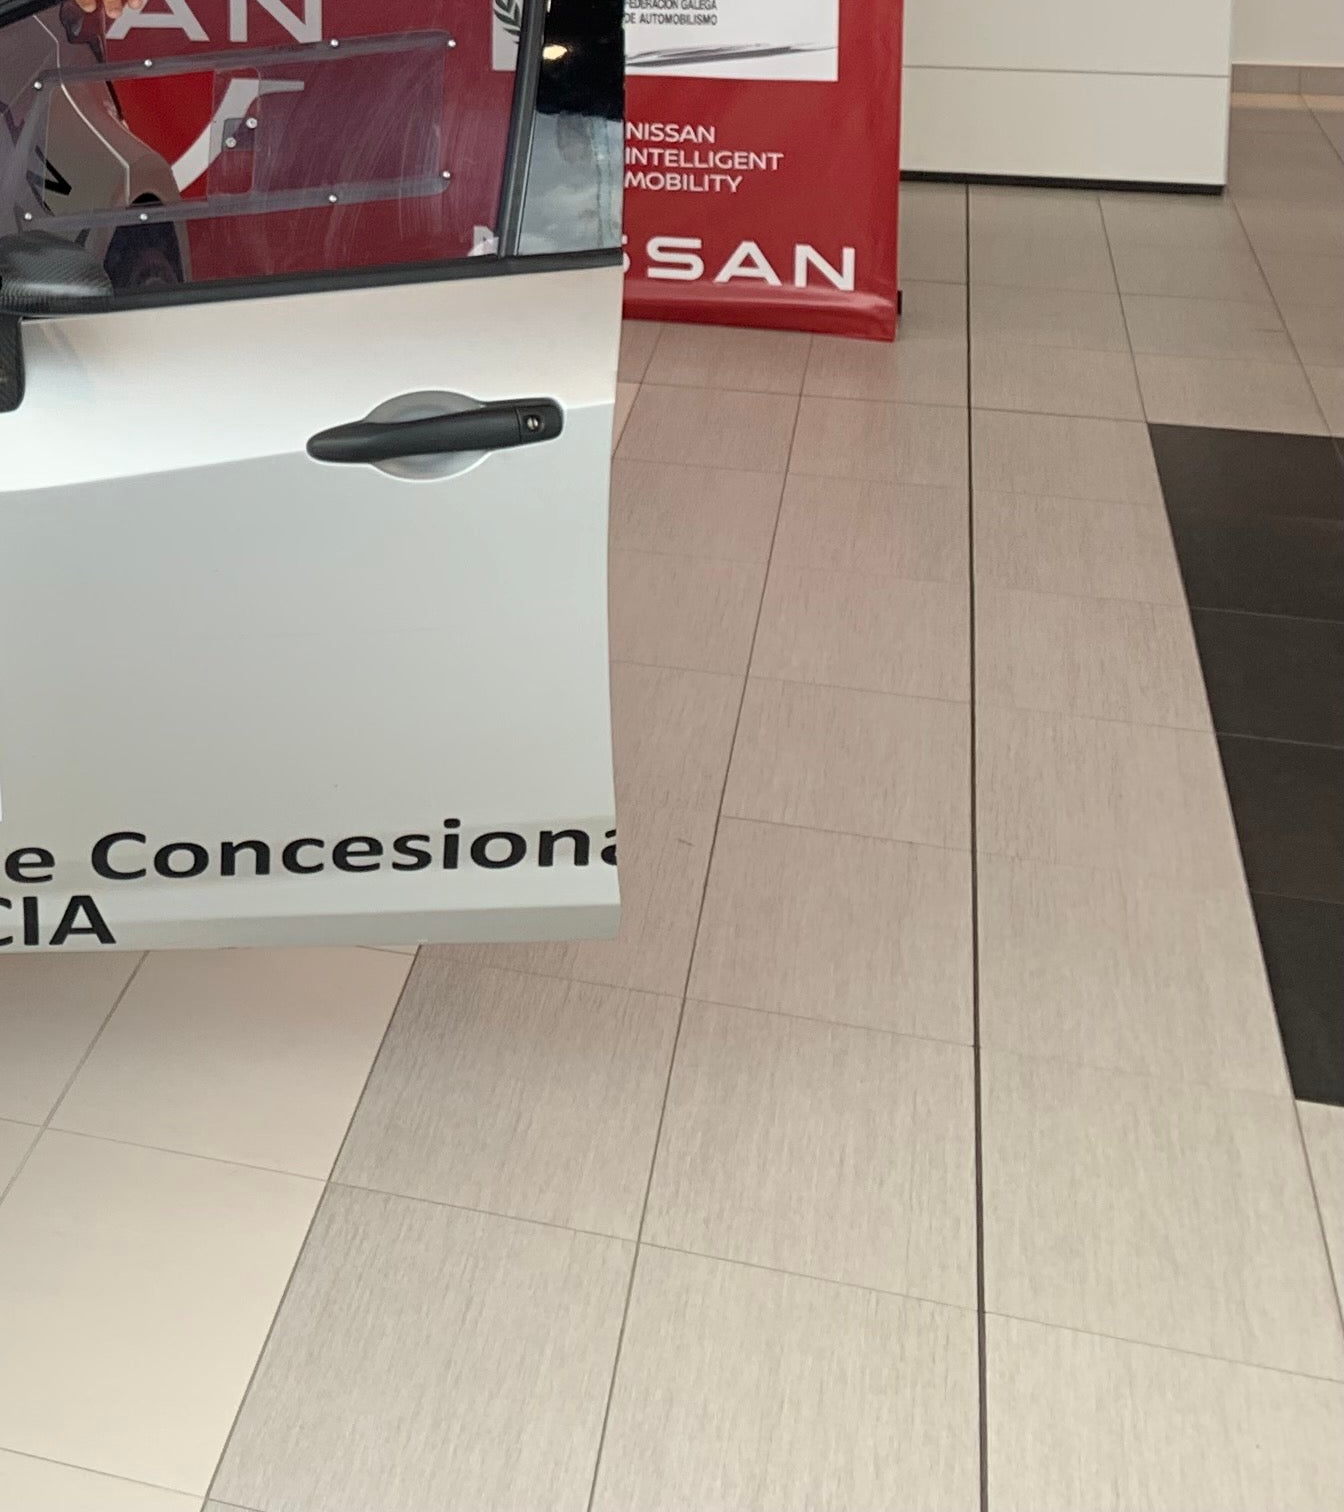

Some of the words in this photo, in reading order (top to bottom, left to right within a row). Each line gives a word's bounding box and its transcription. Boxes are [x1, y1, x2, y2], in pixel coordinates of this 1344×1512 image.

[639, 13, 718, 25] AUTOMOBILISMO
[625, 121, 716, 144] NISSAN
[624, 147, 785, 171] INTELLIGENT
[624, 171, 743, 193] MOBILITY
